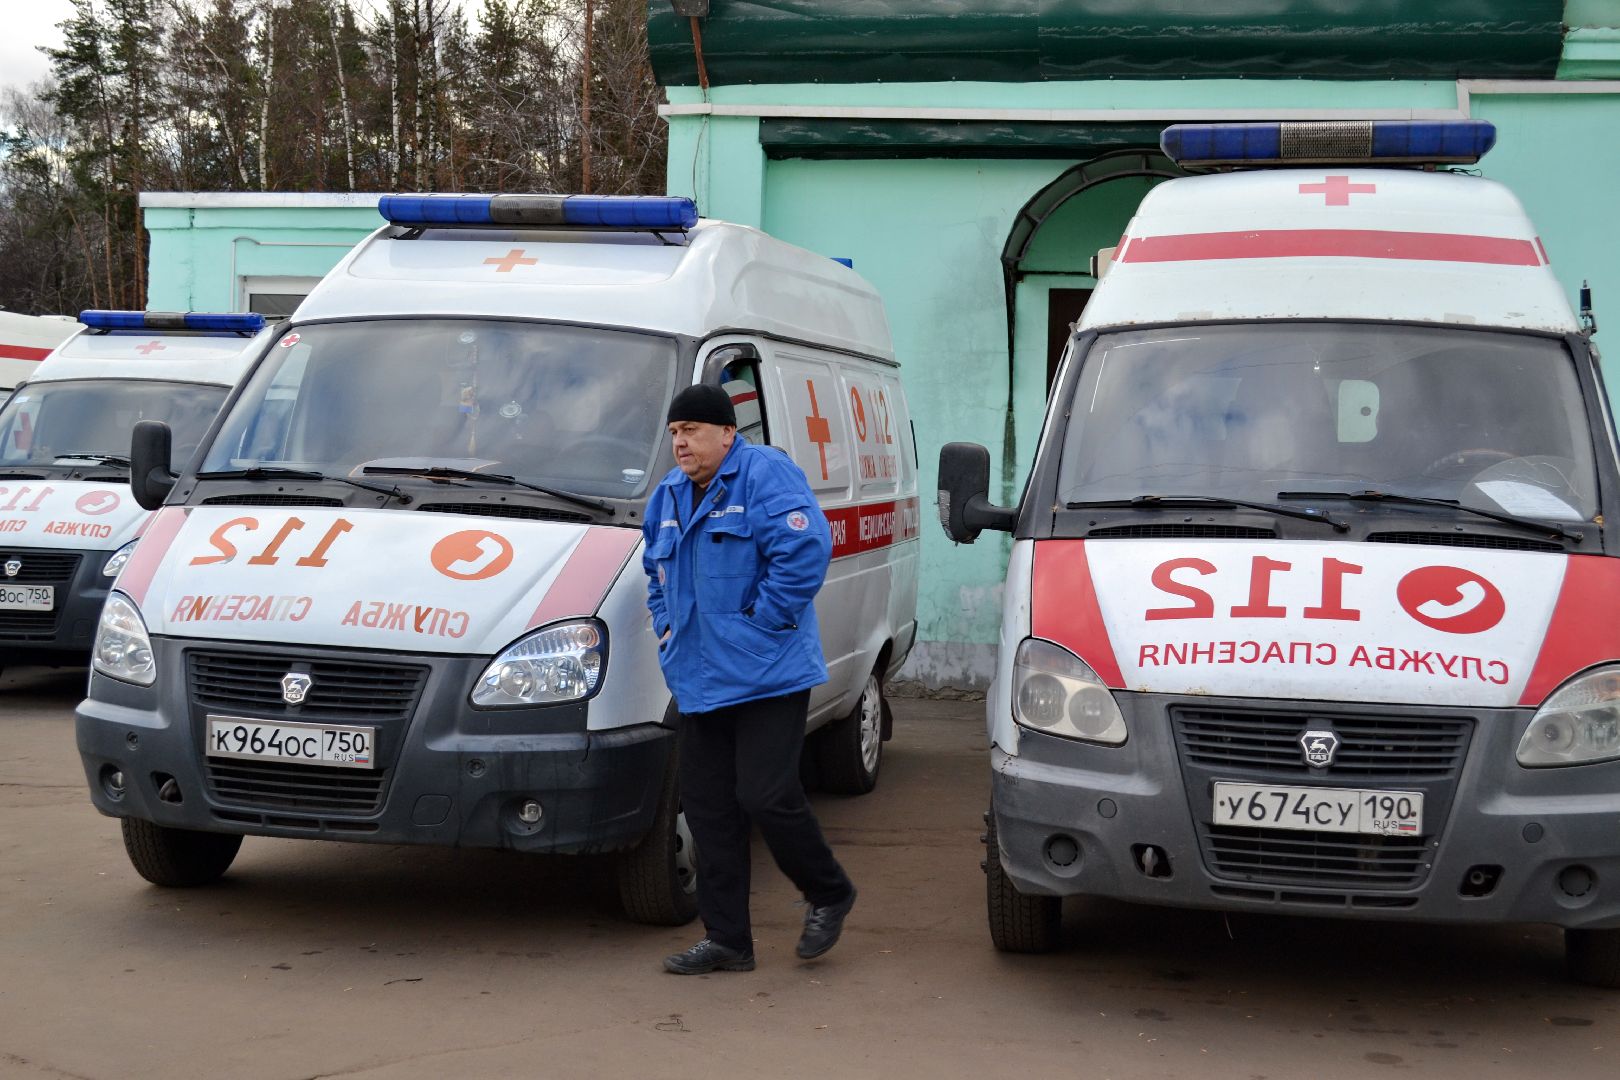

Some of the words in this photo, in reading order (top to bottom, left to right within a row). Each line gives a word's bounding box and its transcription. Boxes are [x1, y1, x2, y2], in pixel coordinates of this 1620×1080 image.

[28, 588, 49, 600] 750
[324, 730, 366, 754] 750
[333, 753, 354, 762] RUS
[1363, 795, 1413, 820] 190
[1373, 820, 1399, 829] RUS
